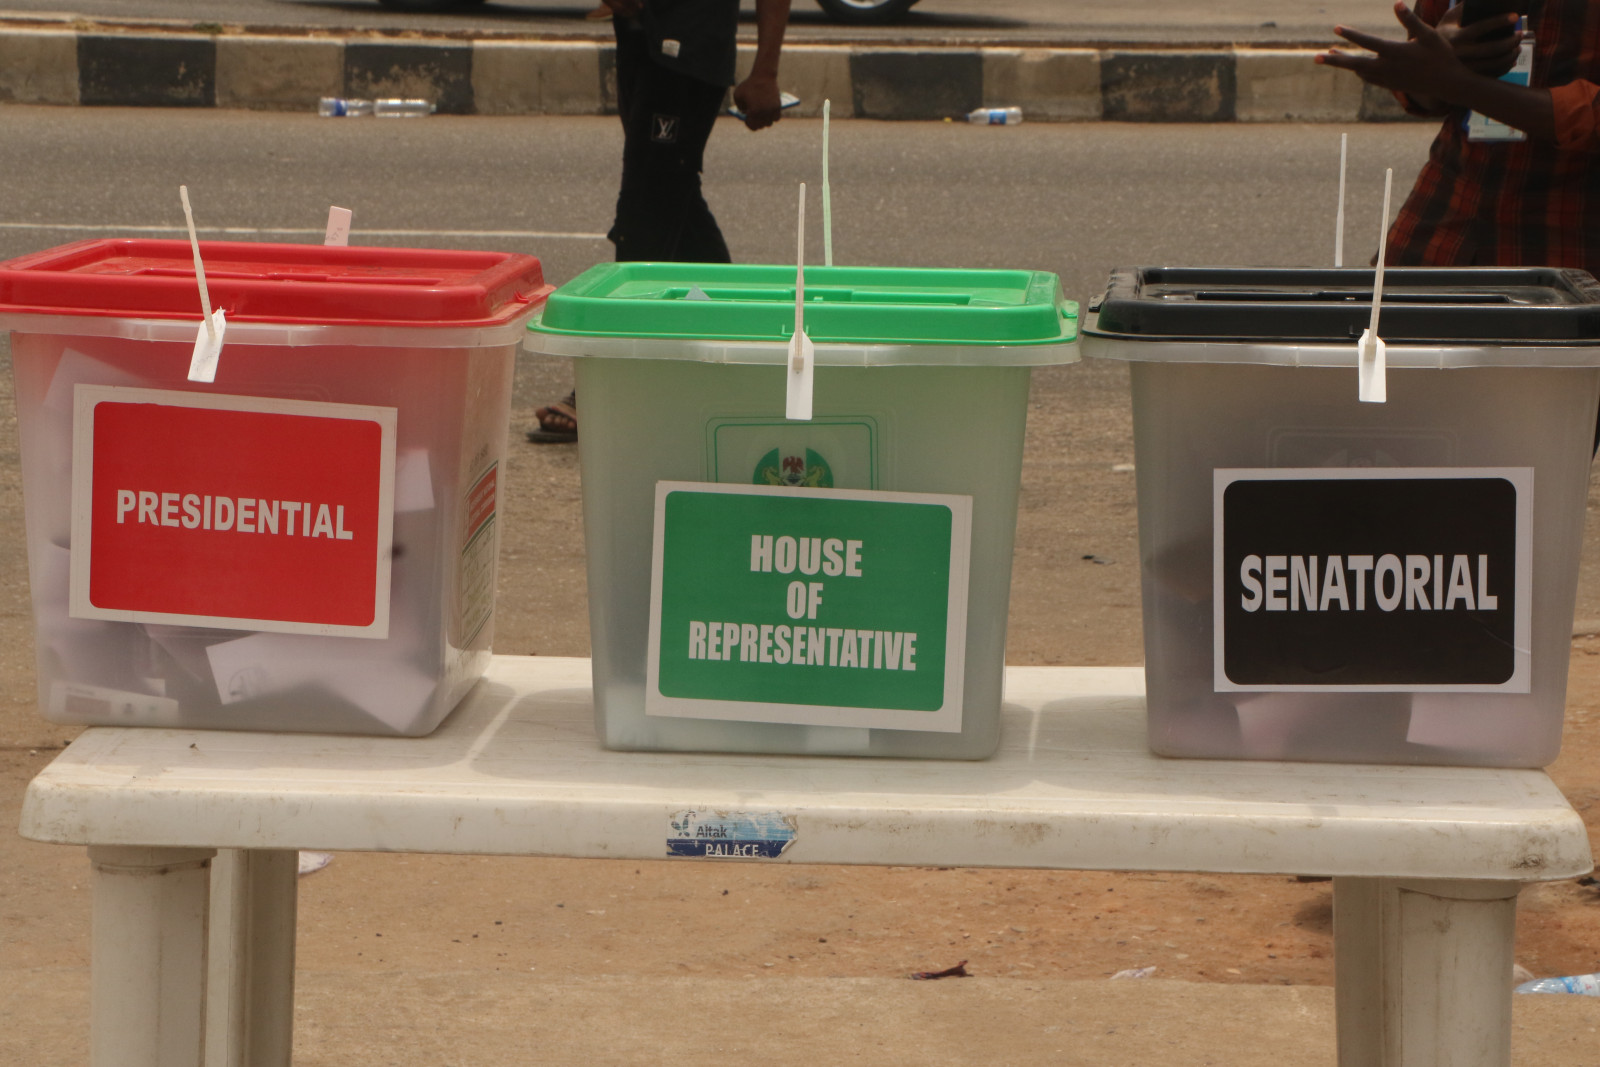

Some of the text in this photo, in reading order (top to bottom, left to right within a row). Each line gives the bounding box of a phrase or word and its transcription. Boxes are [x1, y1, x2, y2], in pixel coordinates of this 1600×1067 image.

[117, 489, 354, 540] PRESIDENTIAL
[751, 535, 863, 577] HOUSE
[786, 581, 823, 620] OF
[1240, 554, 1498, 612] SENATORIAL
[688, 621, 918, 671] REPRESENTATIVE
[705, 843, 759, 856] PALACE
